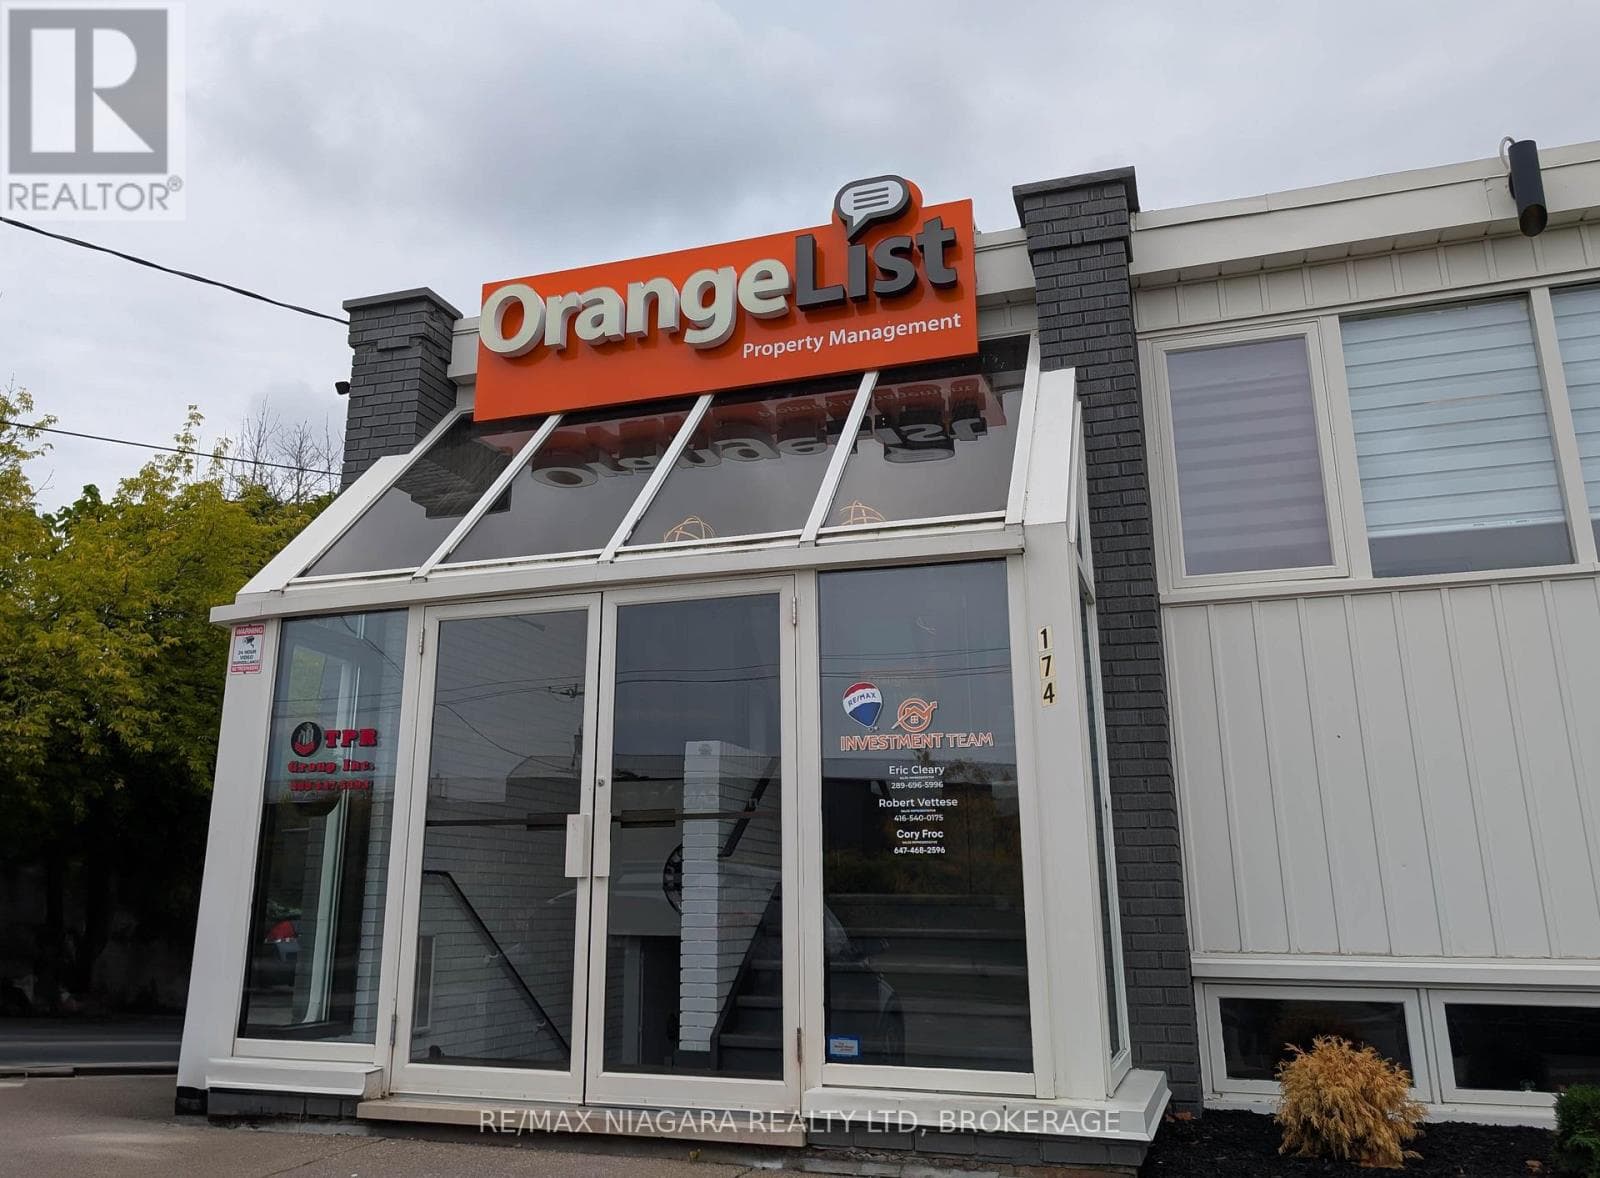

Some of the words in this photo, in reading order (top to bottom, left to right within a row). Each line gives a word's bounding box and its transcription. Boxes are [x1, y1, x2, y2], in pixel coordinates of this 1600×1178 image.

[479, 216, 957, 358] OrangeList
[743, 335, 823, 358] Property
[829, 313, 961, 346] Management
[848, 692, 877, 707] RE/MAX
[324, 728, 378, 748] TPR
[840, 733, 943, 751] INVESTMENT
[945, 732, 994, 748] TEAM
[888, 765, 909, 775] Eric
[911, 765, 945, 776] Cleary
[878, 798, 915, 807] Robert
[917, 798, 958, 807] Vettese
[896, 829, 920, 840] Cory
[922, 829, 944, 838] Froc
